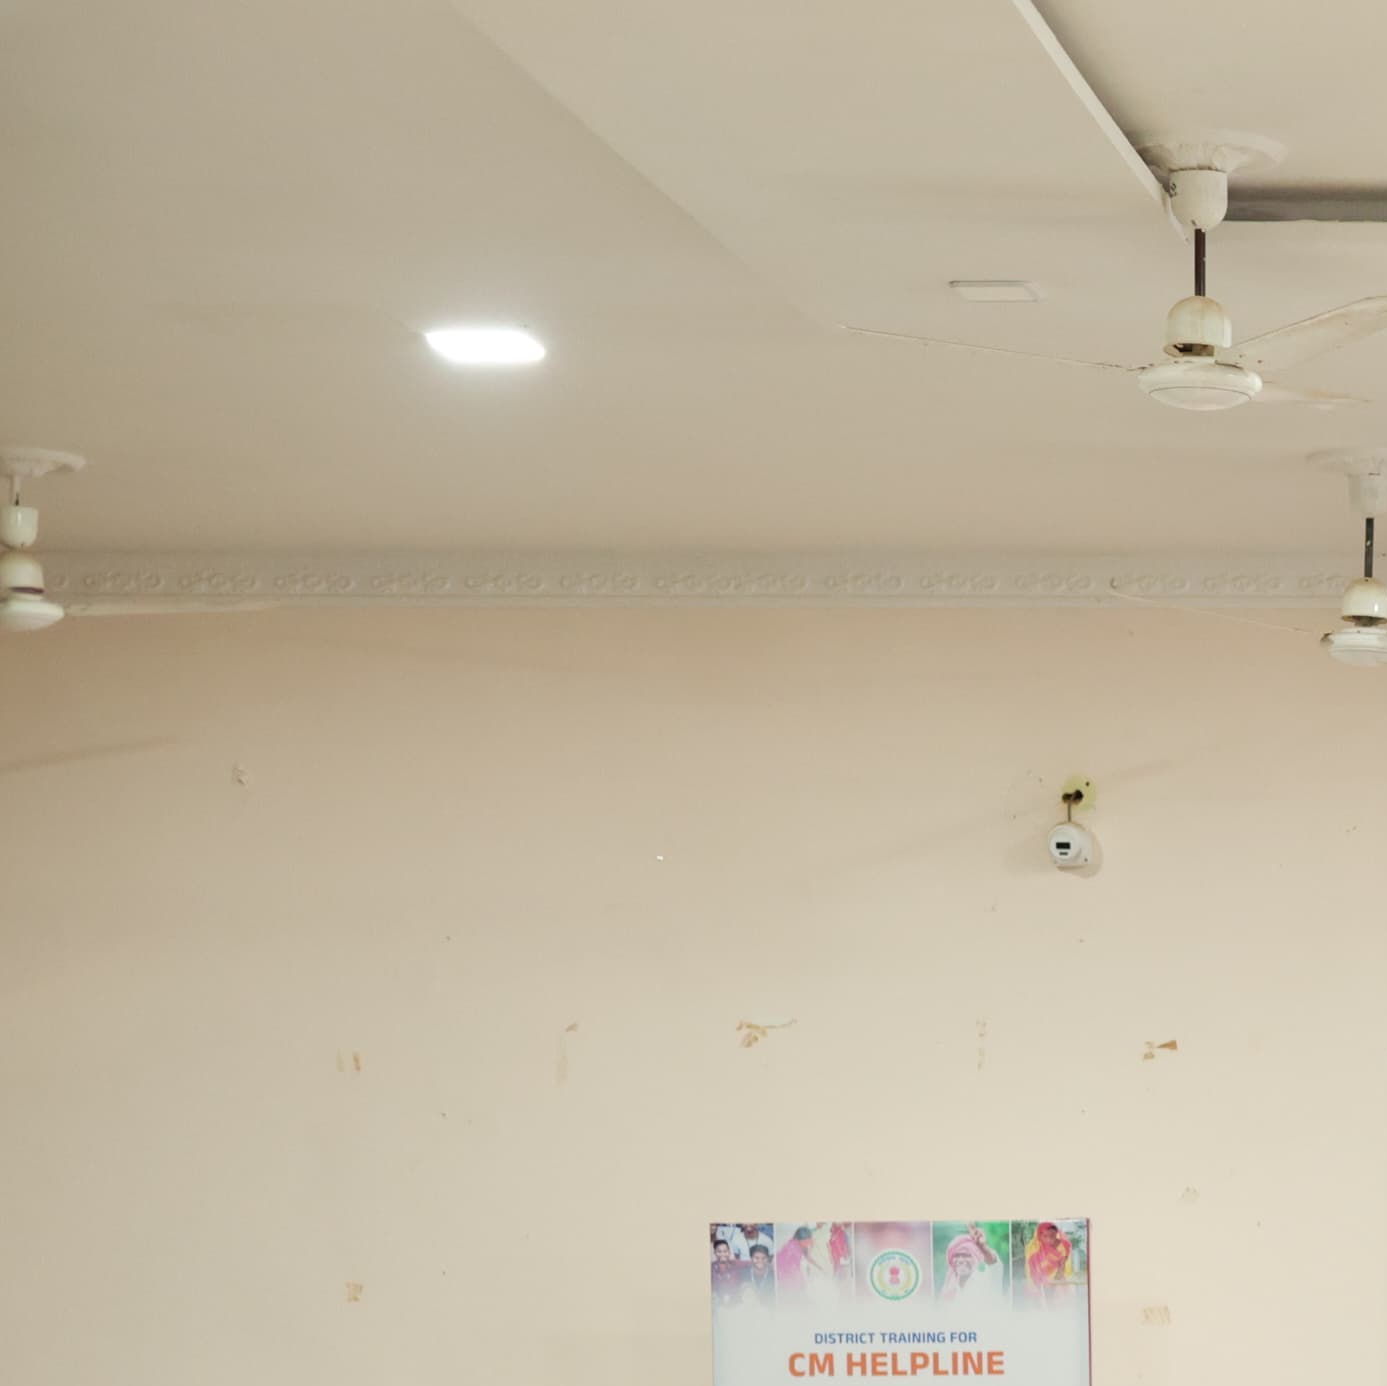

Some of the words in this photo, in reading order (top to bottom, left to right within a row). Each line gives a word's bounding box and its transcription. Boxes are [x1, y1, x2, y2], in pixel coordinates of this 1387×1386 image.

[814, 1332, 875, 1345] DISTRICT
[880, 1331, 946, 1344] TRAINING
[950, 1331, 978, 1343] FOR
[788, 1352, 834, 1377] CM
[846, 1351, 1005, 1377] HELPLINE
